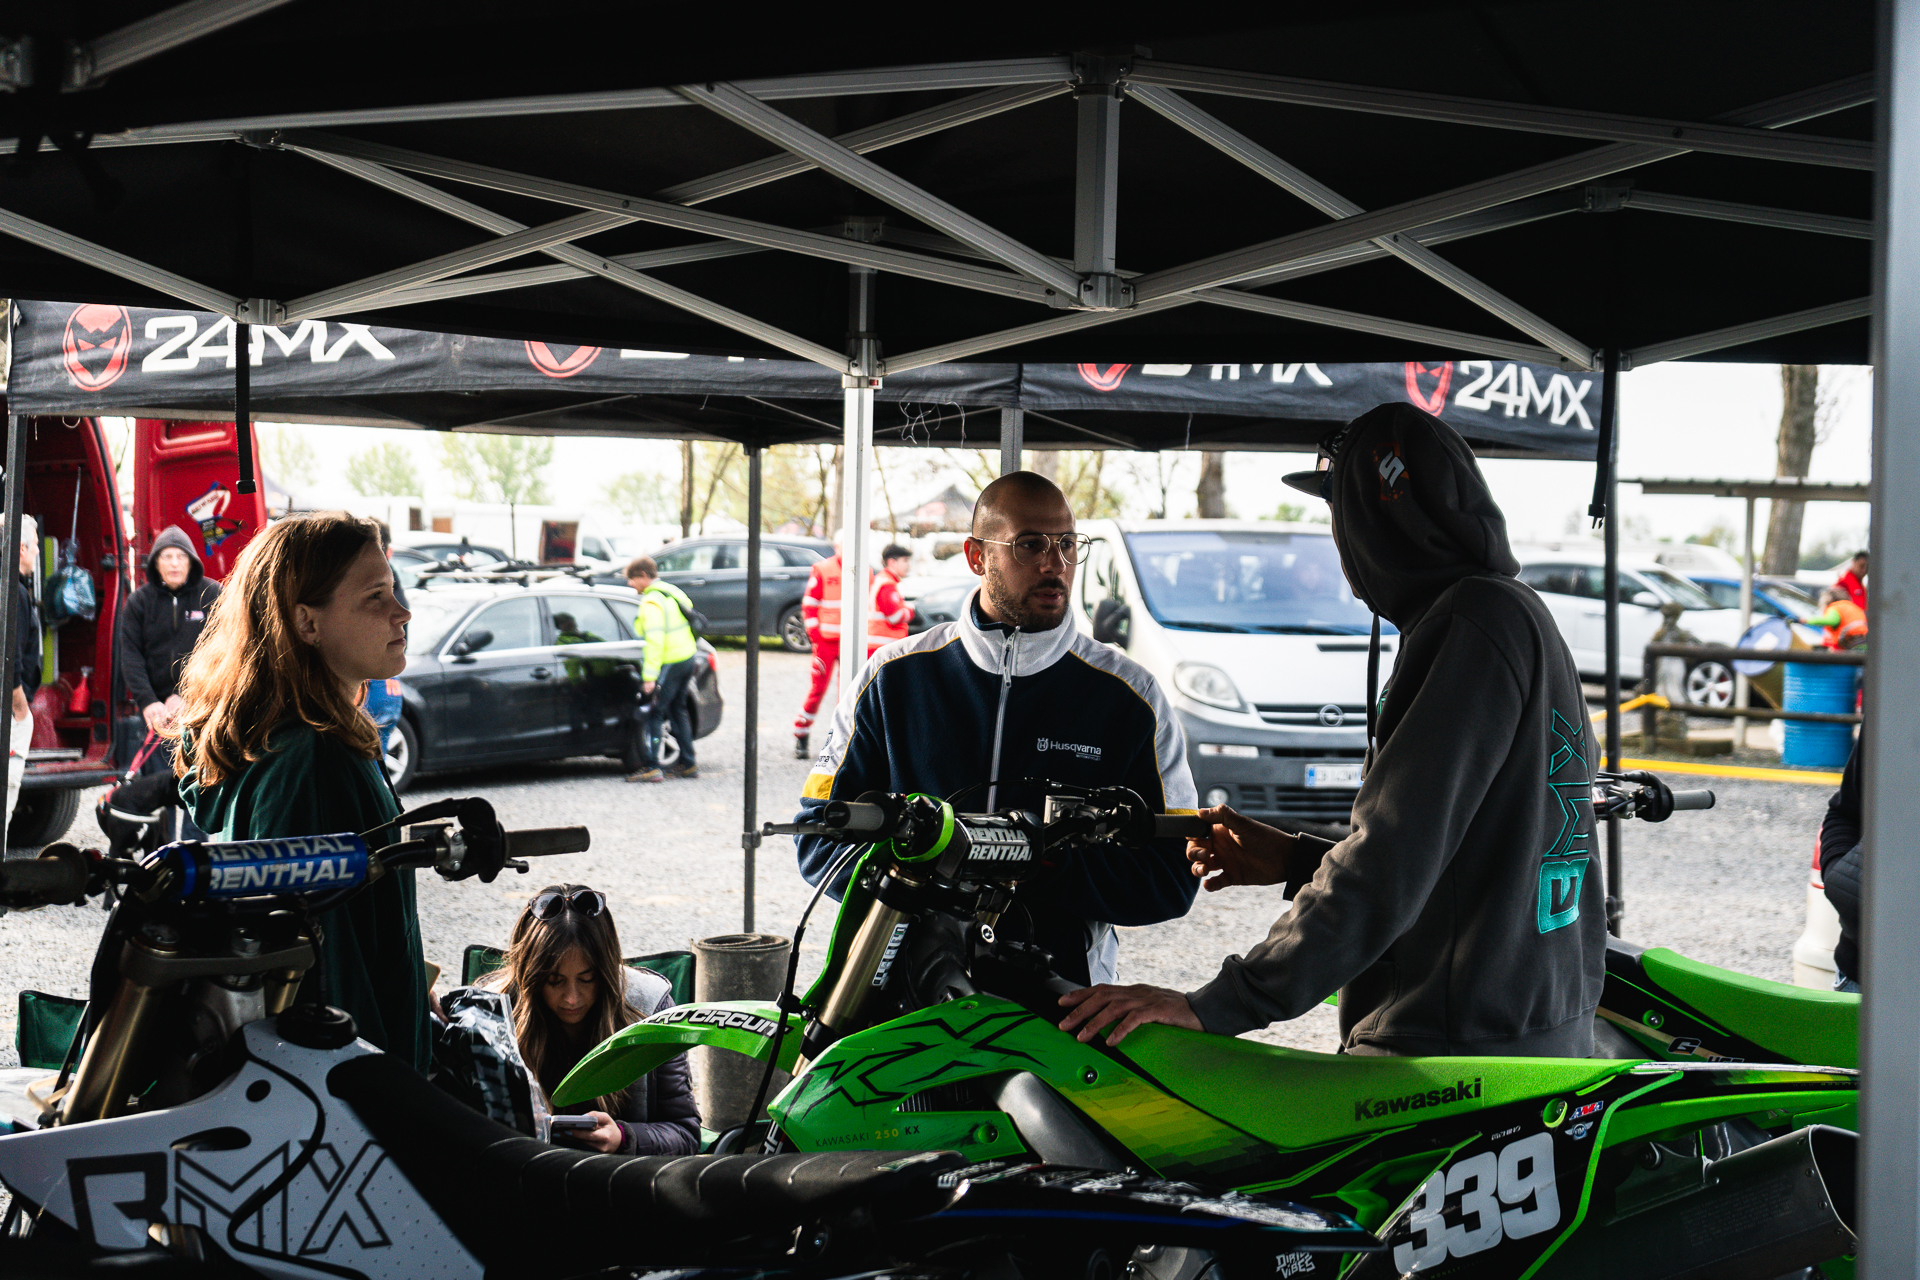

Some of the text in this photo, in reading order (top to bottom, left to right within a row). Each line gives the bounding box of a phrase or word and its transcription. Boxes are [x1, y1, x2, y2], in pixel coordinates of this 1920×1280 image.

[141, 315, 397, 373] 24MX
[1454, 360, 1595, 431] 24MX
[1049, 740, 1102, 756] Husqvarna
[967, 826, 1031, 842] RENTHA
[1354, 1077, 1482, 1122] Kawasaki
[815, 1124, 921, 1148] KAWASAKI 250 KX
[1393, 1131, 1561, 1275] 339
